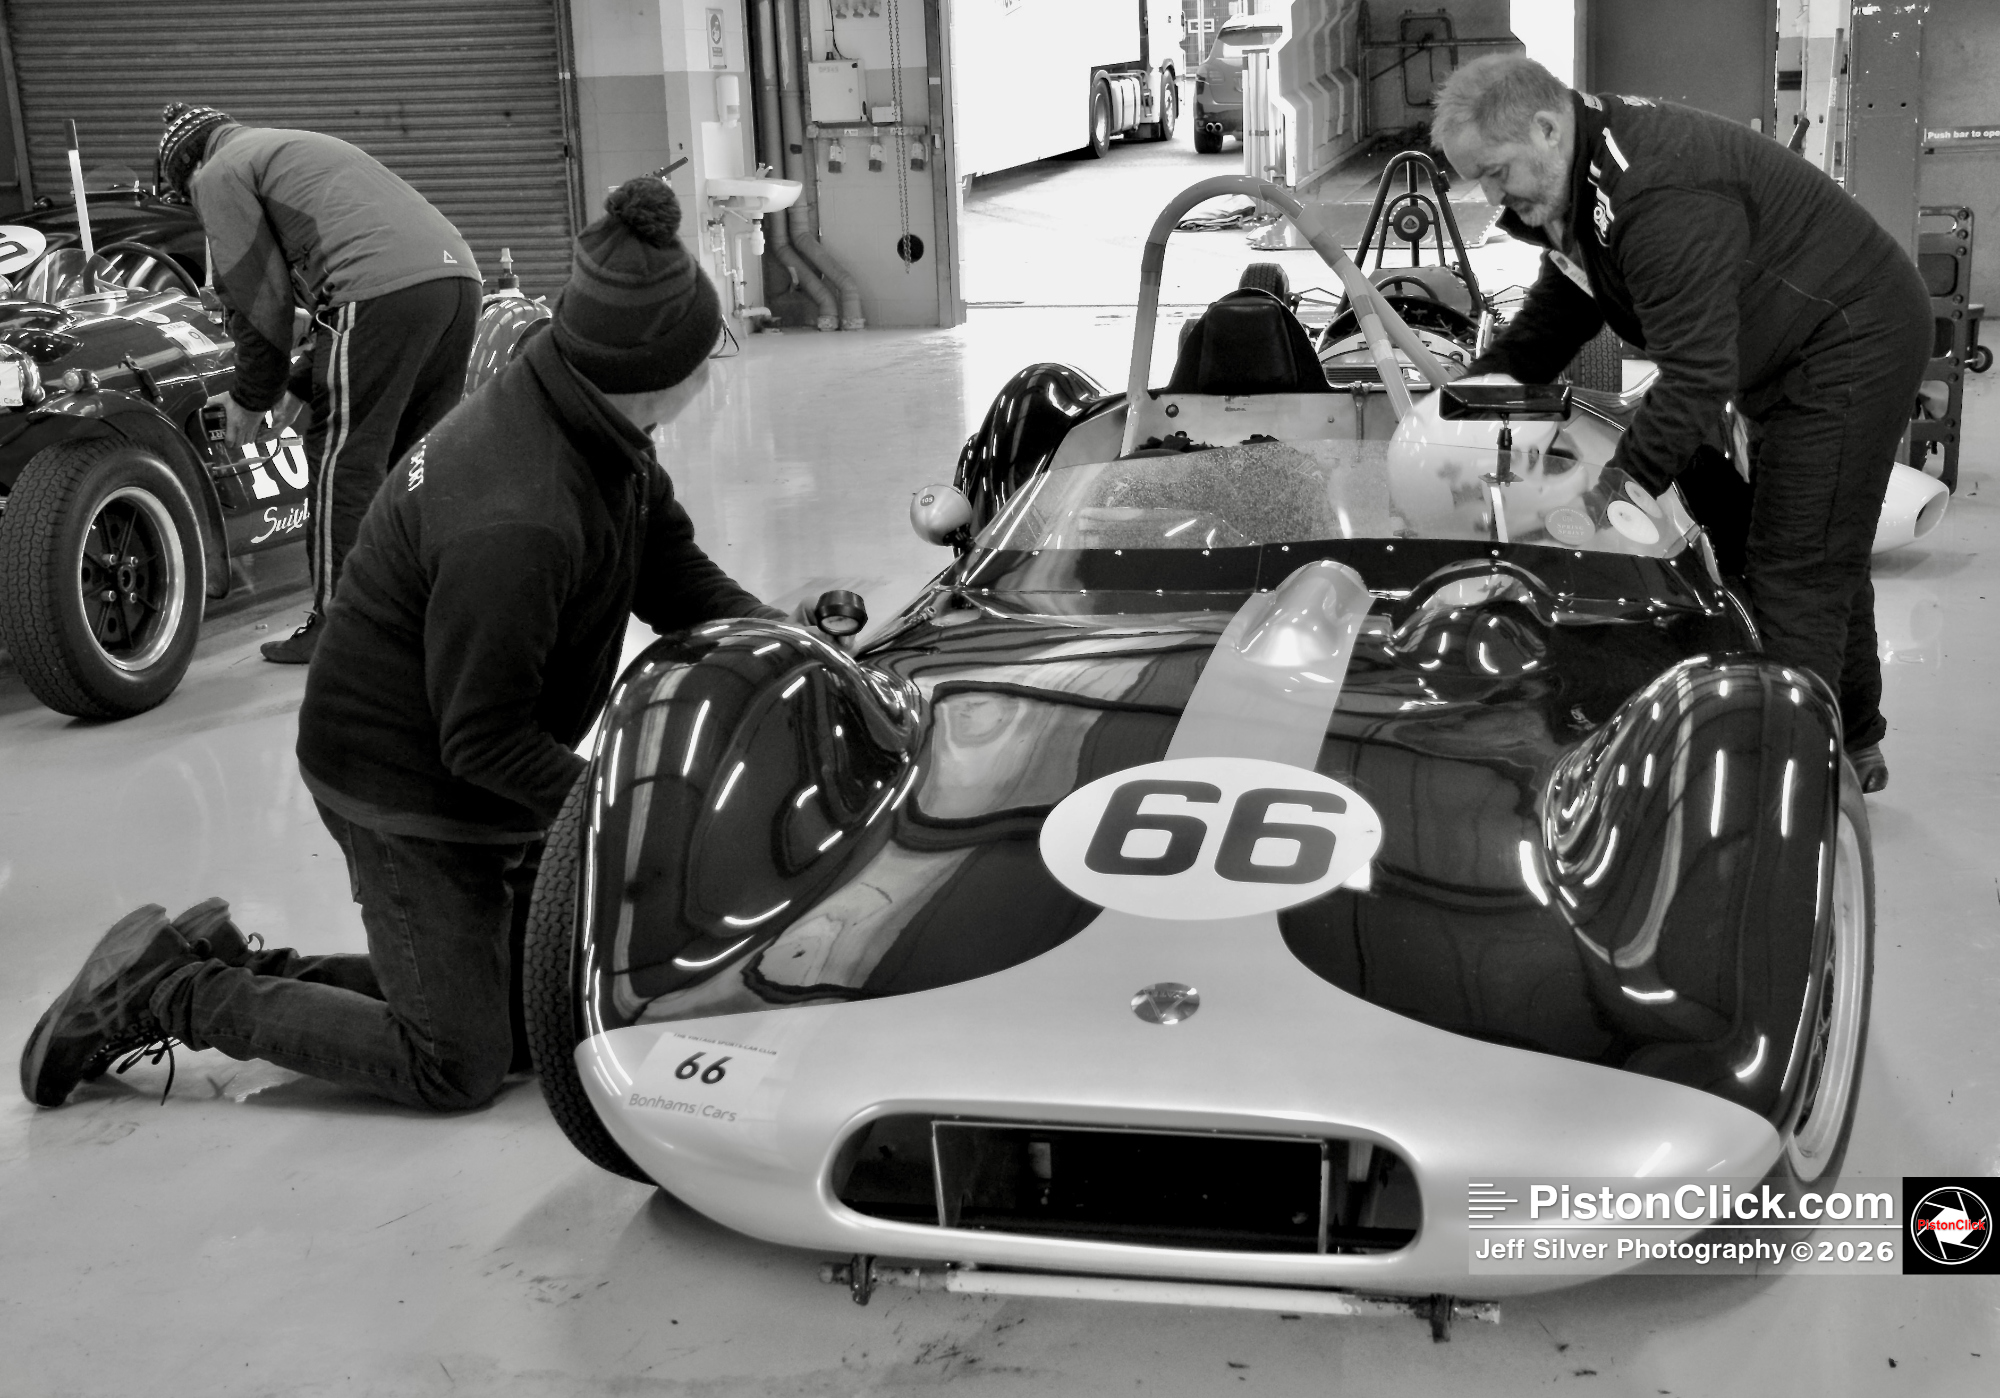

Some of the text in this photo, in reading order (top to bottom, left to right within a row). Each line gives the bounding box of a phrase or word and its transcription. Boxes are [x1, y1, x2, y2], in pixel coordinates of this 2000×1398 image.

[1927, 129, 2000, 139] Push bar to ope
[1084, 779, 1347, 885] 66
[688, 1035, 716, 1044] VINTAGE
[758, 1047, 778, 1056] CLUB
[674, 1051, 733, 1085] 66
